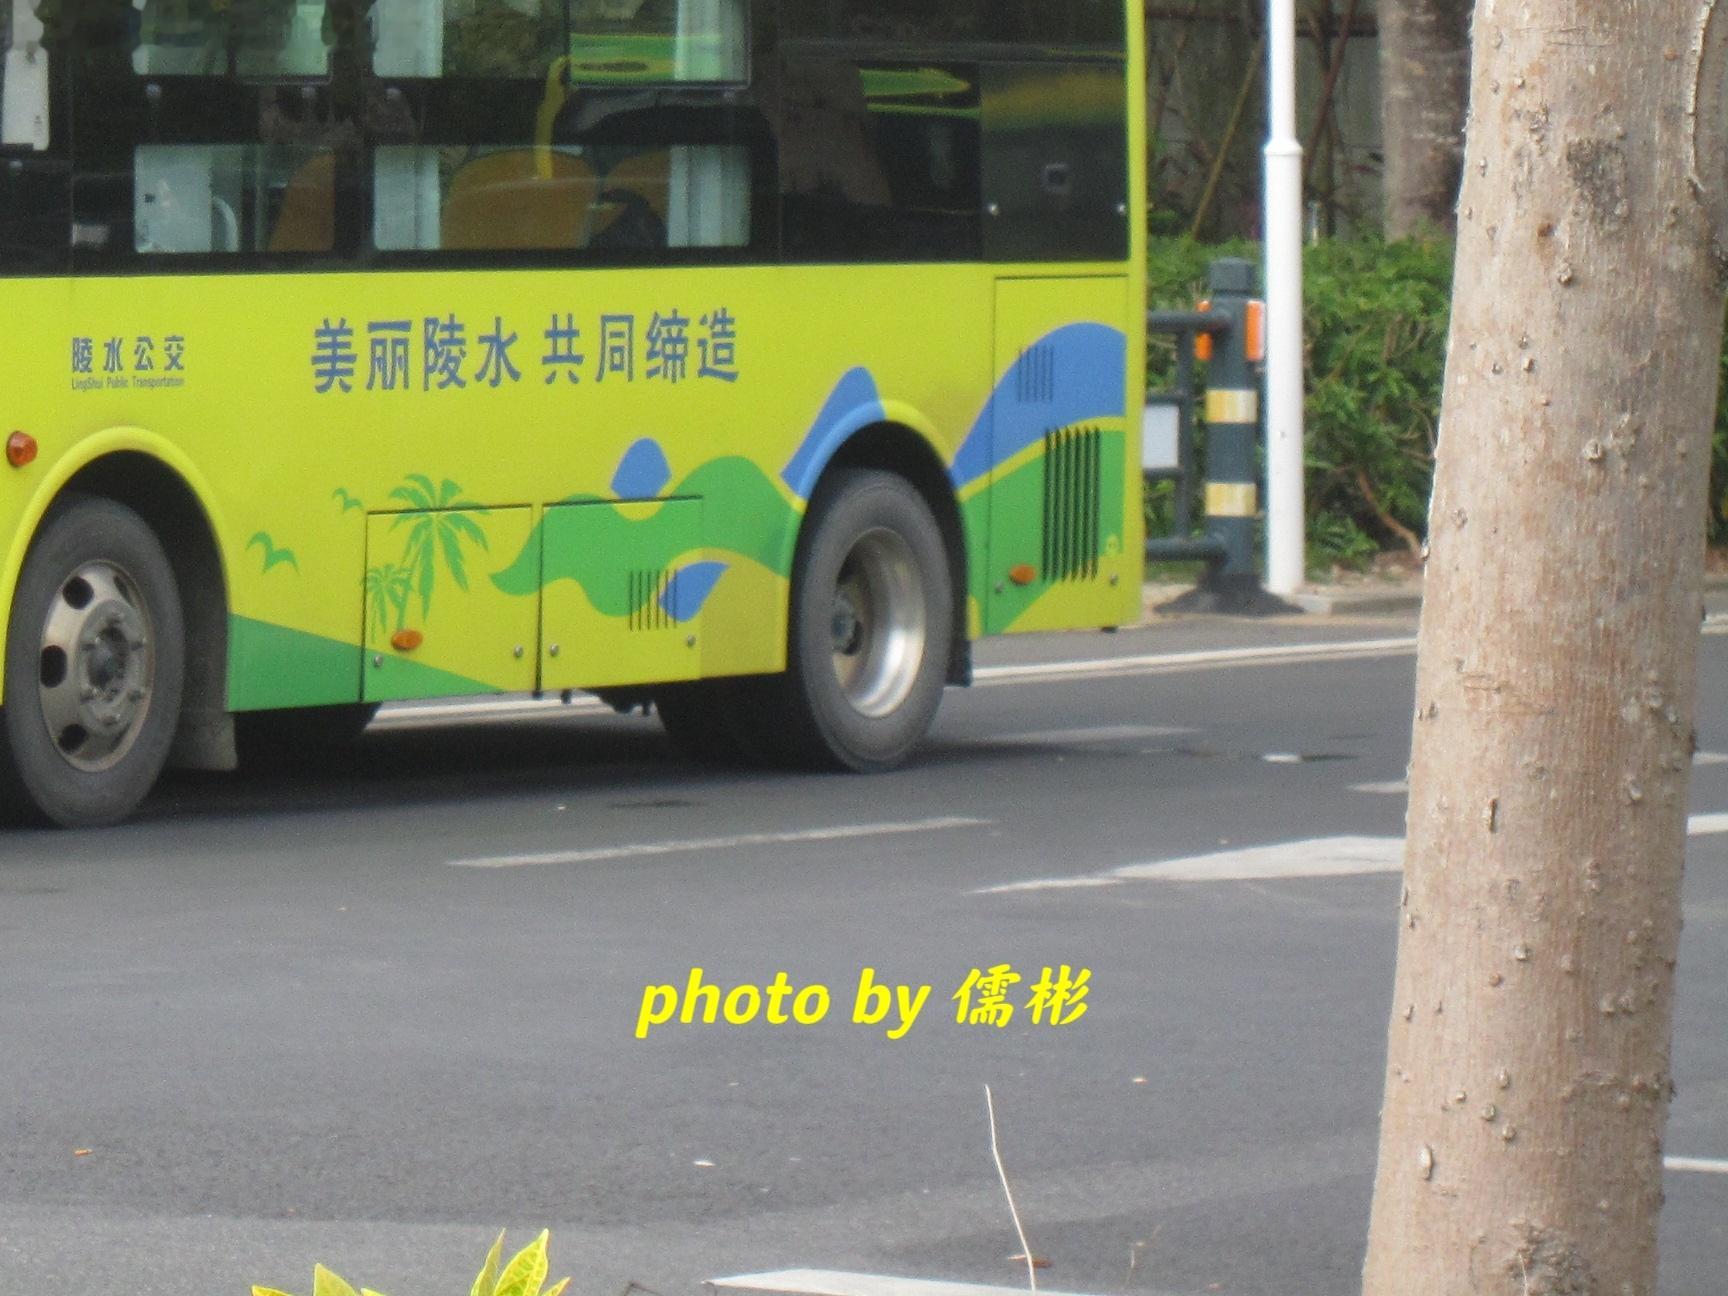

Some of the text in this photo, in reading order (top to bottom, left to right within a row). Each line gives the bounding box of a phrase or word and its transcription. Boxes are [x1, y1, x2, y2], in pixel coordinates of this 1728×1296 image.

[71, 334, 185, 373] 陵水公交
[310, 307, 740, 394] 美丽陵水 共同缔造
[106, 376, 129, 389] Public
